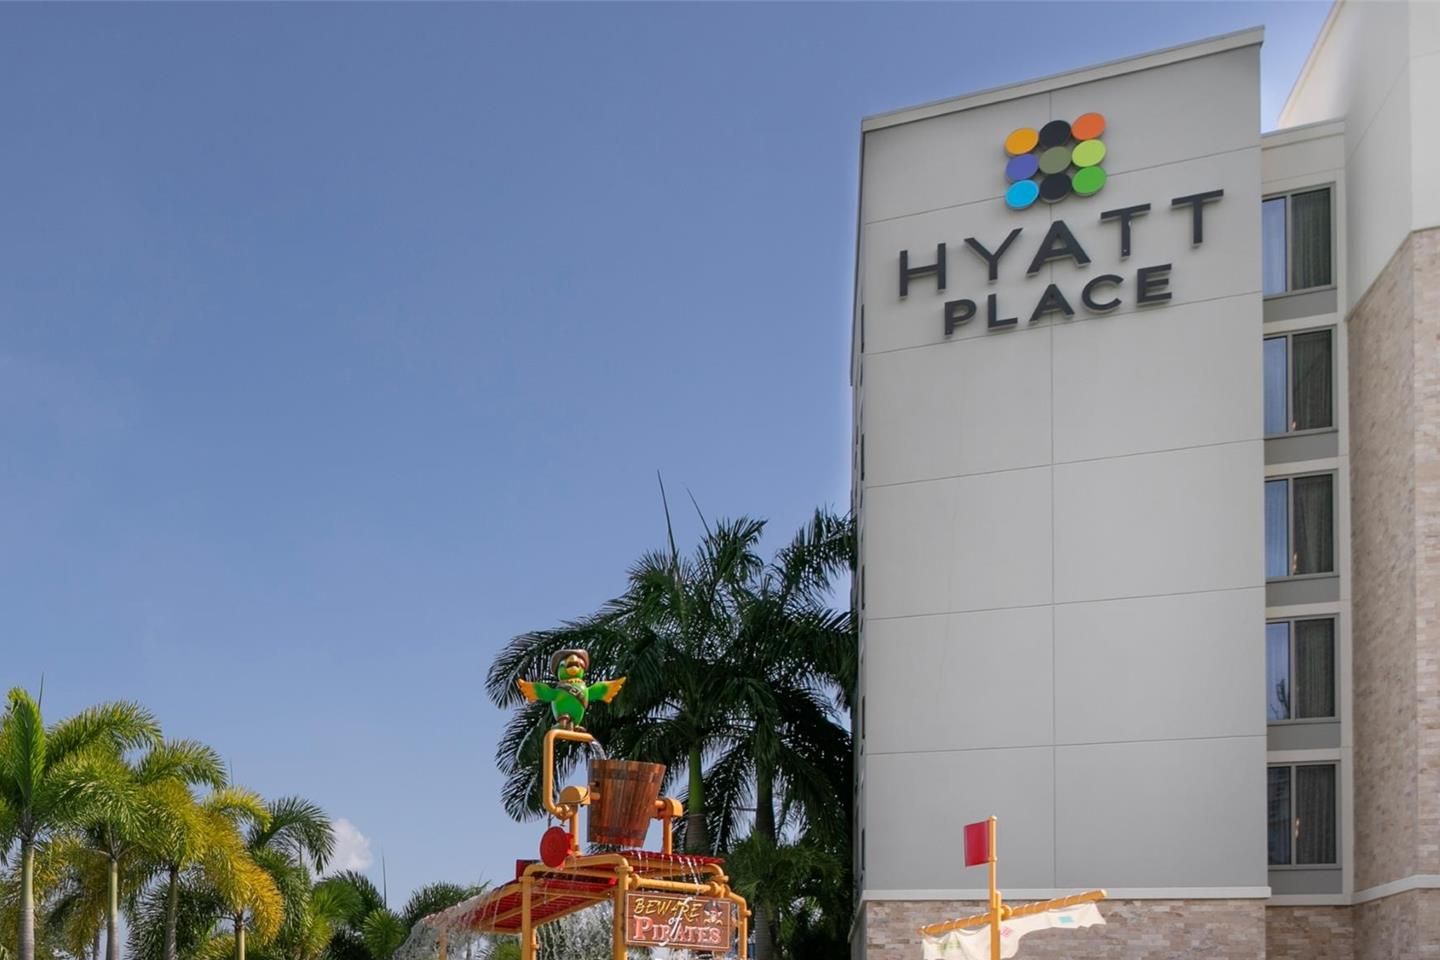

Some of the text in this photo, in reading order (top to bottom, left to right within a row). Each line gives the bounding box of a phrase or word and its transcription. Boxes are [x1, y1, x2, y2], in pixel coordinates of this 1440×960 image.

[898, 189, 1225, 298] HYATT
[943, 263, 1173, 337] PLACE
[632, 914, 722, 944] PIRATES
[633, 897, 702, 922] BEWARE
